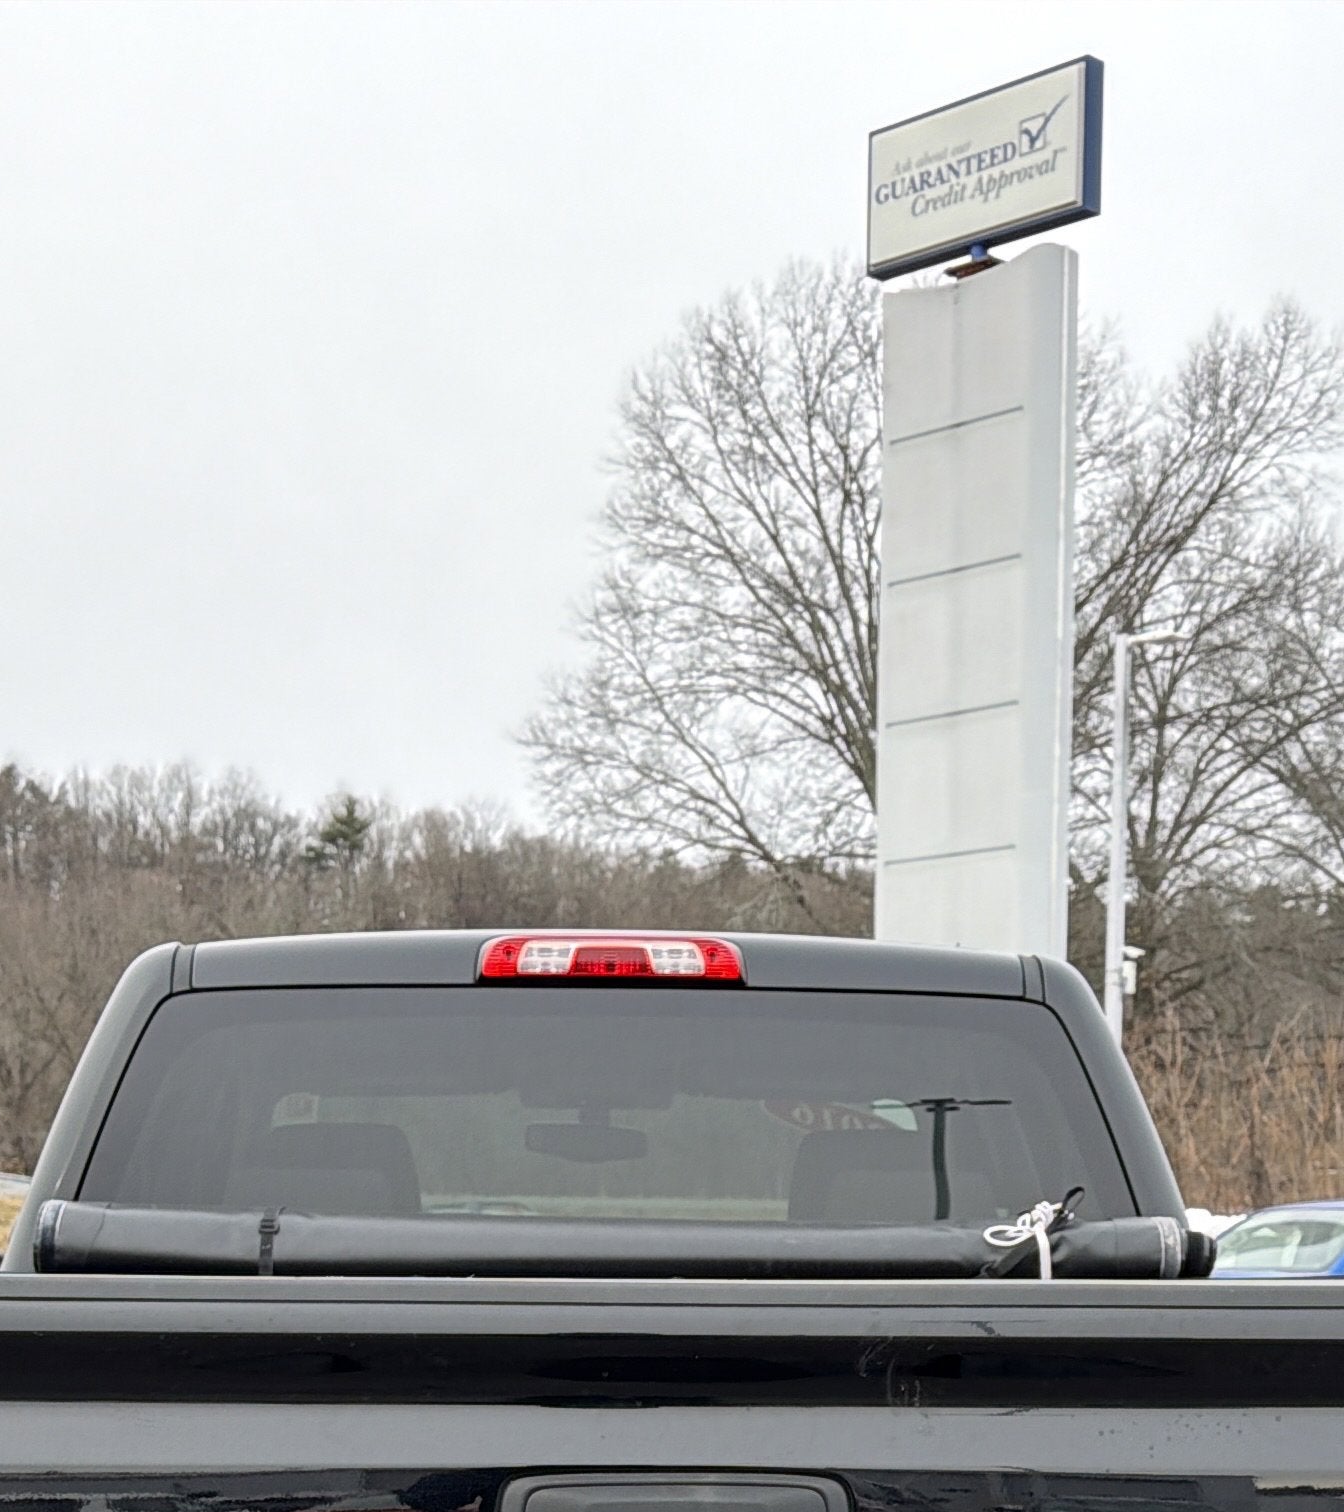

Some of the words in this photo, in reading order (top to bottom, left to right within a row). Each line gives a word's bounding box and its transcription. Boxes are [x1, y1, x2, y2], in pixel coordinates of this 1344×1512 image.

[875, 141, 1017, 205] GUARANTEED
[911, 182, 966, 217] Credit
[969, 149, 1058, 203] Approval
